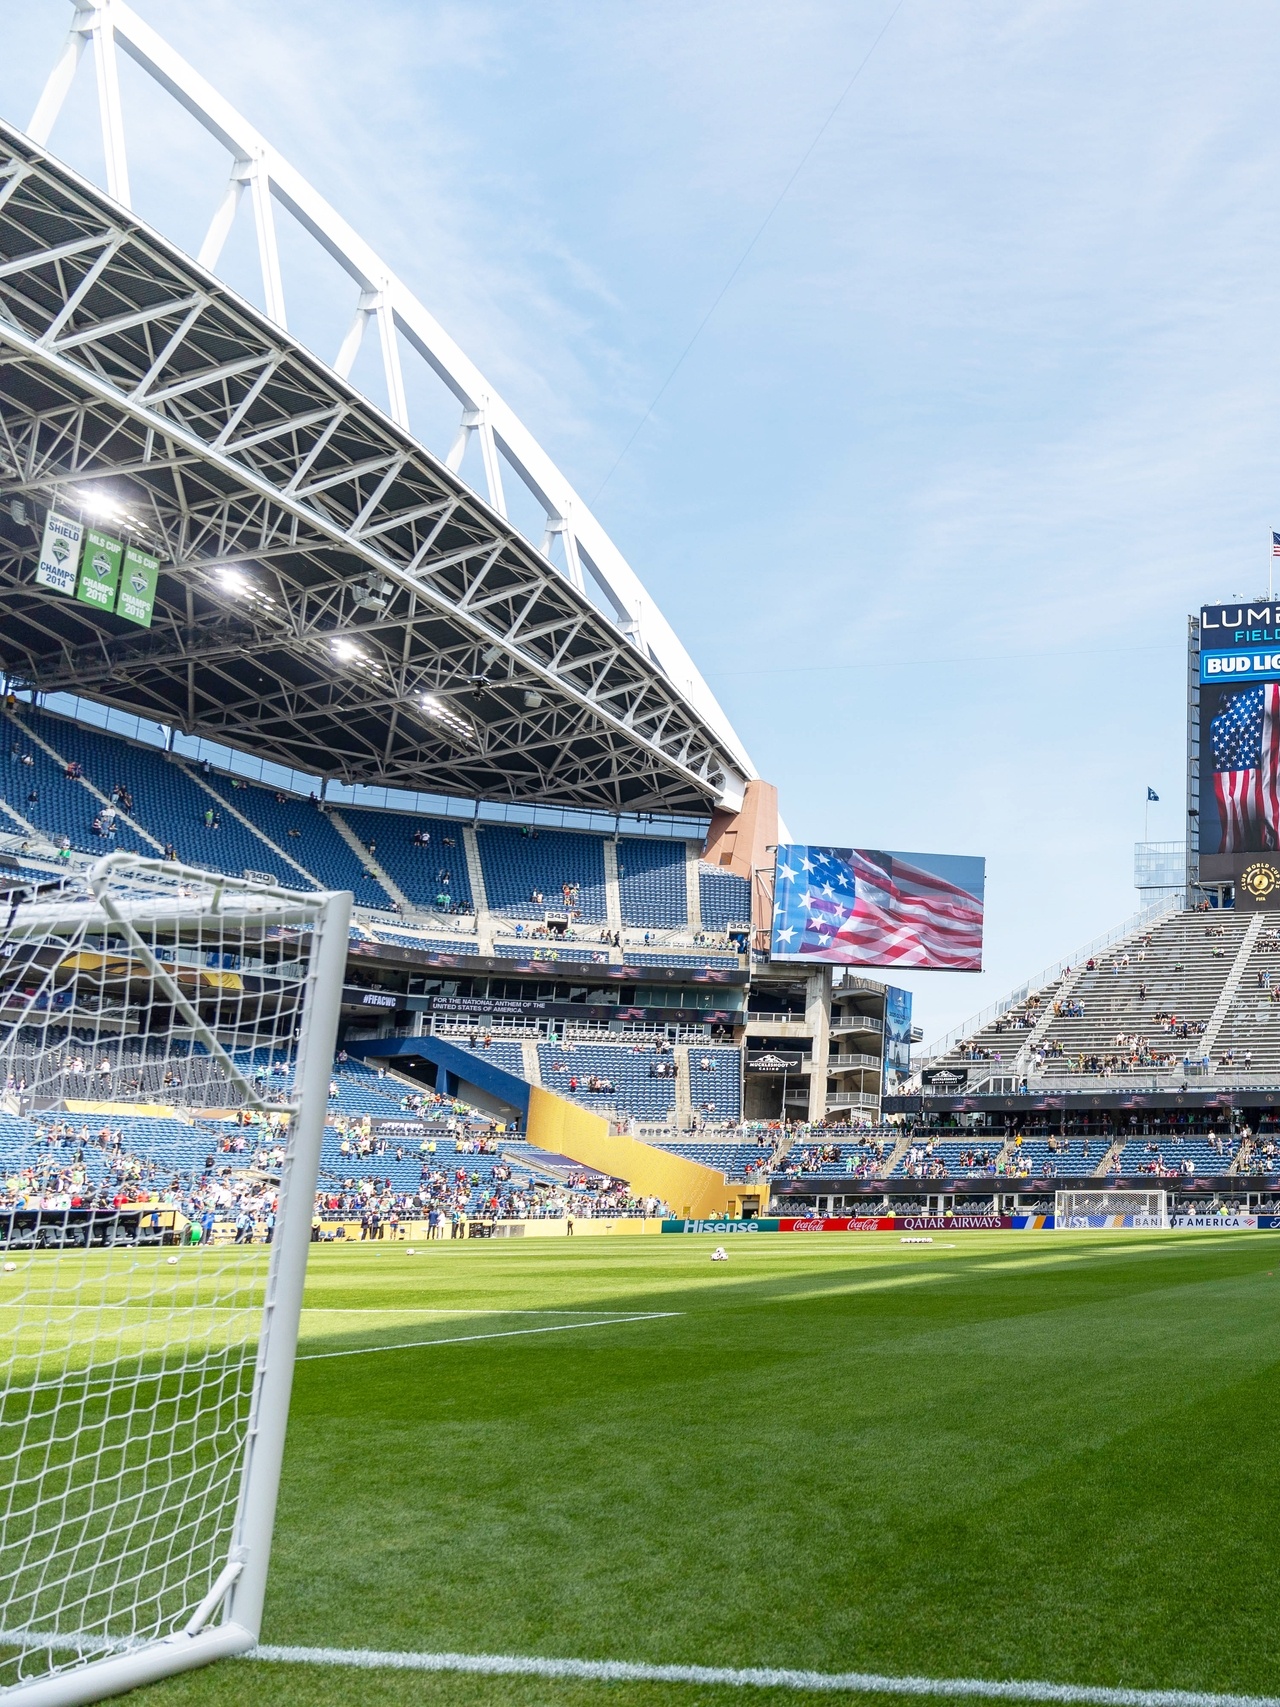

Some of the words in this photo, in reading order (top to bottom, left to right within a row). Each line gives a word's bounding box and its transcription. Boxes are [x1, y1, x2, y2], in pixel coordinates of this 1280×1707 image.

[48, 522, 80, 541] SHIELD
[89, 533, 105, 548] MLS
[105, 540, 121, 554] CUP
[127, 550, 143, 564] MLS
[143, 556, 158, 570] CUP
[40, 561, 75, 582] CHAMPS
[46, 573, 66, 588] 2014
[82, 576, 114, 597] CHAMPS
[86, 587, 108, 604] 2016
[121, 592, 151, 612] CHAMPS
[124, 602, 145, 619] 2019
[1207, 655, 1251, 674] BUD
[547, 912, 569, 920] 343
[362, 994, 397, 1007] #FIFACWC
[462, 998, 494, 1006] NATIONAL
[492, 1006, 523, 1014] AMERICA.
[683, 1219, 759, 1233] Hisense
[904, 1217, 945, 1230] QATAR
[951, 1216, 1001, 1229] AIRWAYS
[1135, 1217, 1163, 1227] BAN
[1188, 1218, 1240, 1227] AMERICA
